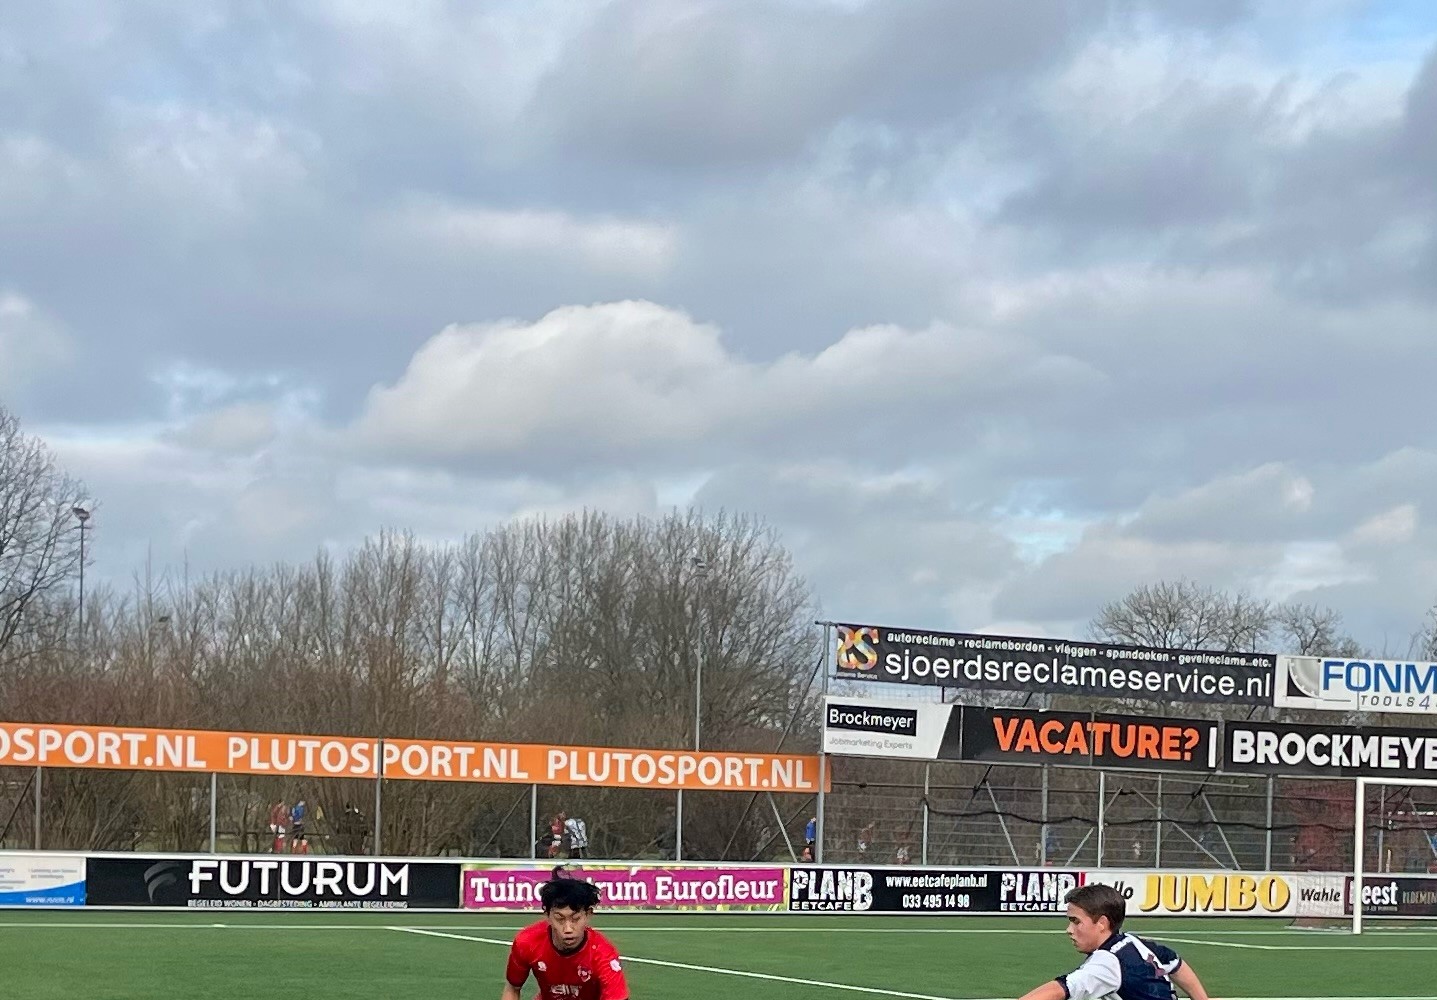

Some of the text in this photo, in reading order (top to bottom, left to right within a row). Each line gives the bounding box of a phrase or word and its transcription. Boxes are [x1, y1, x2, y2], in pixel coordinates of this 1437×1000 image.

[887, 632, 955, 647] autoreclame
[965, 639, 1045, 652] reclameborden
[1055, 643, 1096, 657] vlaggen
[1106, 648, 1169, 662] spandoeken
[885, 649, 1271, 697] sjoerdsreclameservice.nl
[829, 709, 914, 730] Brockmeyer
[829, 736, 913, 750] Jobmarketing Experts
[993, 716, 1200, 761] VACATURE?
[228, 737, 528, 779] PLUTOSPORT.NL
[547, 749, 812, 788] PLUTOSPORT.NL
[188, 860, 409, 896] FUTURUM
[471, 875, 778, 903] Tuinrum Eurofleur
[885, 873, 988, 890] www.eetcafeplanb.nl
[188, 899, 408, 909] BEGELEID WONEN DAGBESTEDING AMBULANTE BEGELEIDING
[902, 894, 921, 908] 033
[923, 894, 942, 908] 495
[944, 894, 955, 908] 14
[1138, 873, 1291, 913] JUMBO
[1300, 887, 1341, 902] Wahle
[1349, 881, 1398, 905] eest
[792, 902, 852, 911] EETCAFE
[1001, 902, 1057, 911] EETCAFE
